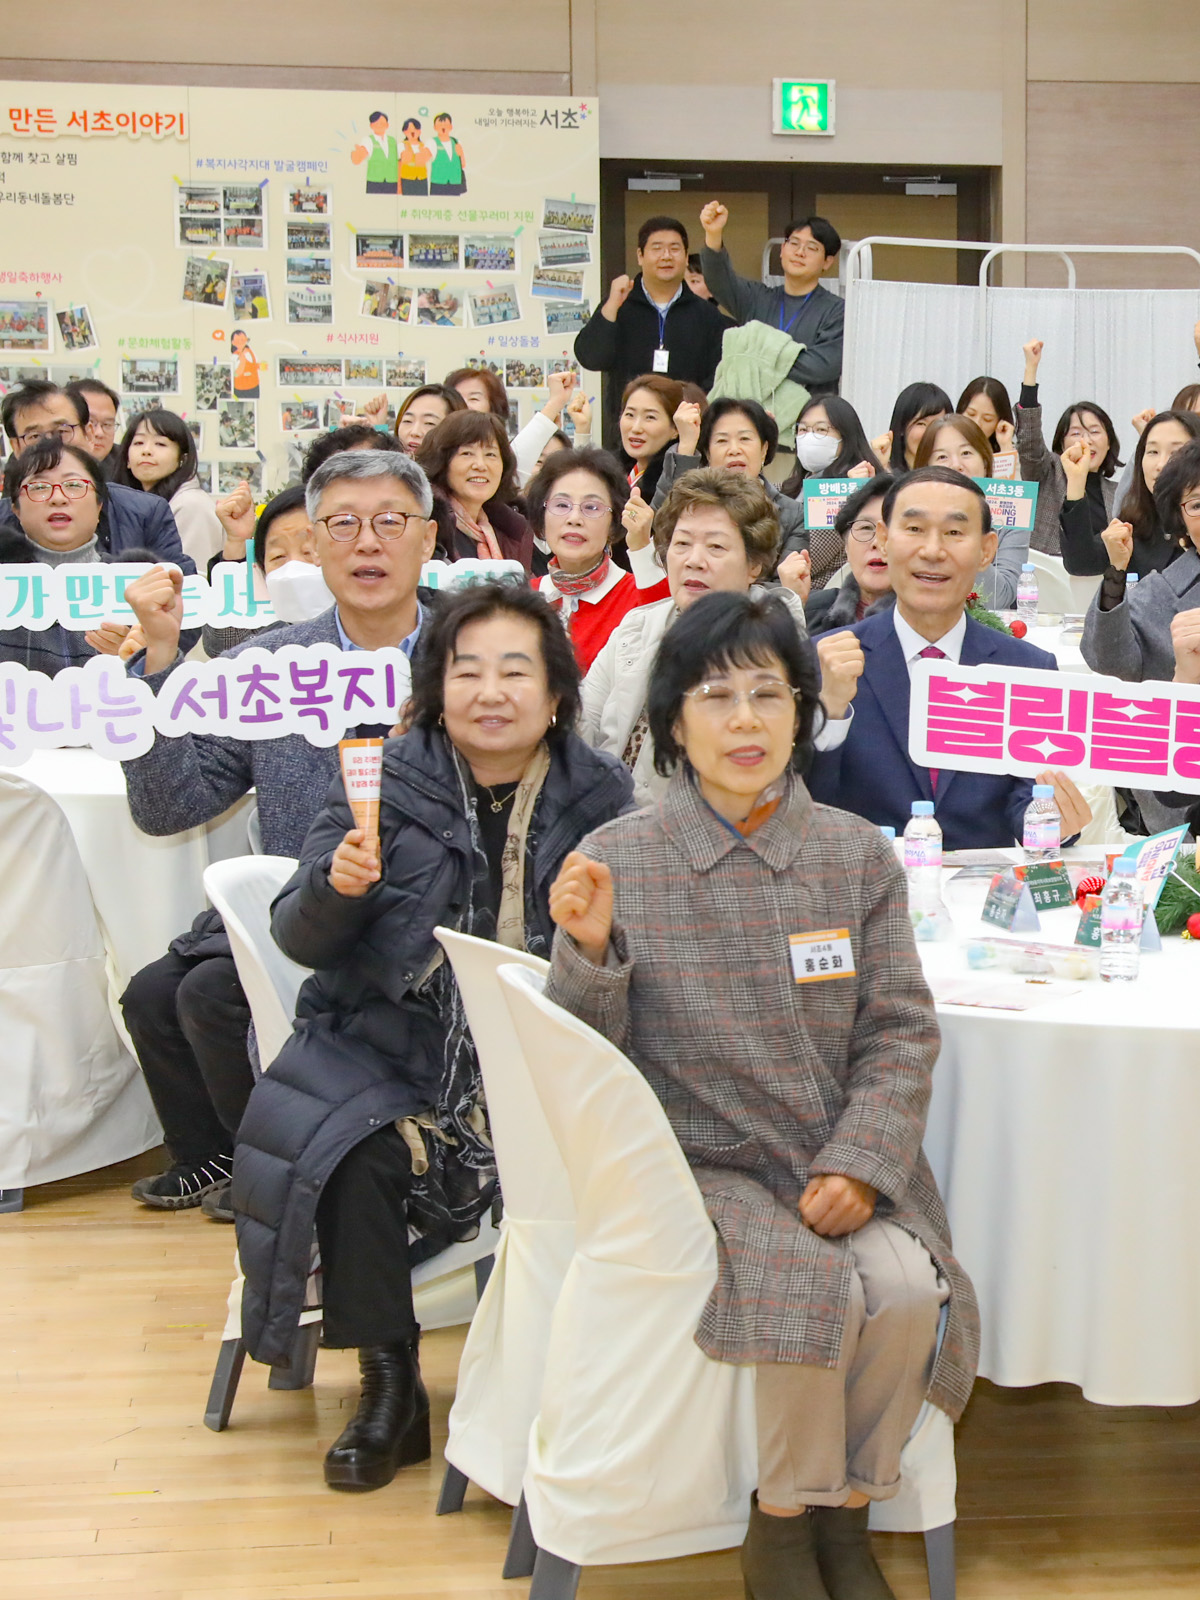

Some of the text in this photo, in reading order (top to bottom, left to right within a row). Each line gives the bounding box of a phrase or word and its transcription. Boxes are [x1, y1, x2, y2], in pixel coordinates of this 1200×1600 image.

[488, 108, 537, 117] 오늘 행복하고
[539, 107, 580, 129] 서초
[8, 108, 184, 136] 만든 서초이야기
[27, 152, 51, 165] 찾고
[55, 153, 78, 166] 살핌
[273, 160, 328, 173] 발굴캠페인
[457, 209, 510, 222] 선물꾸러미
[513, 210, 535, 223] 지원
[985, 483, 1025, 497] 서초3동
[170, 659, 396, 731] 서초복지
